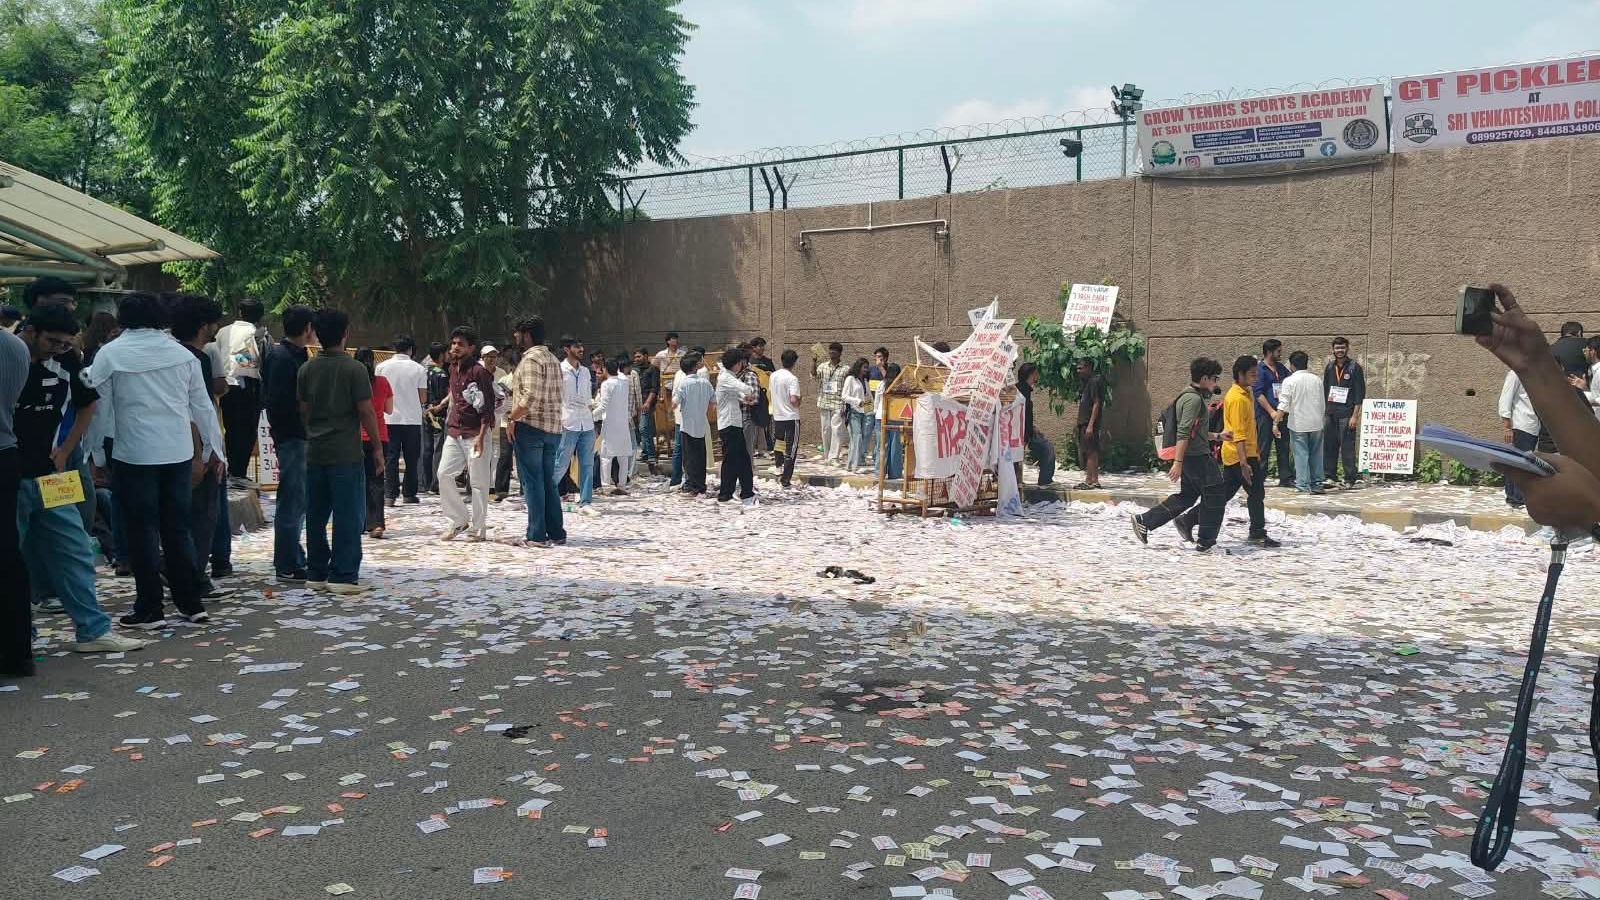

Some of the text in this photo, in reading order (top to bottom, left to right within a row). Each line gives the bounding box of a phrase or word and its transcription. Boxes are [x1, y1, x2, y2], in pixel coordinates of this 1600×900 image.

[1398, 78, 1443, 101] GT
[1528, 92, 1541, 103] AT
[1143, 88, 1372, 126] GROW TENNIS SPORTS ACADEMY
[1447, 113, 1467, 130] SRI
[1471, 102, 1569, 129] VENKATESWARA
[1152, 126, 1162, 137] AT
[1166, 125, 1182, 135] SRI
[1184, 116, 1261, 133] VENKATESWARA
[1264, 111, 1307, 124] COLLEGE
[1310, 109, 1333, 120] NEW
[1337, 105, 1367, 117] DELHI
[1373, 401, 1387, 409] VOTE
[1371, 411, 1386, 420] YASH
[1364, 425, 1369, 434] 3
[1363, 439, 1369, 447] 3
[1363, 452, 1369, 461] 3
[1369, 452, 1395, 461] LAKSHAY
[1369, 462, 1392, 470] SINGH
